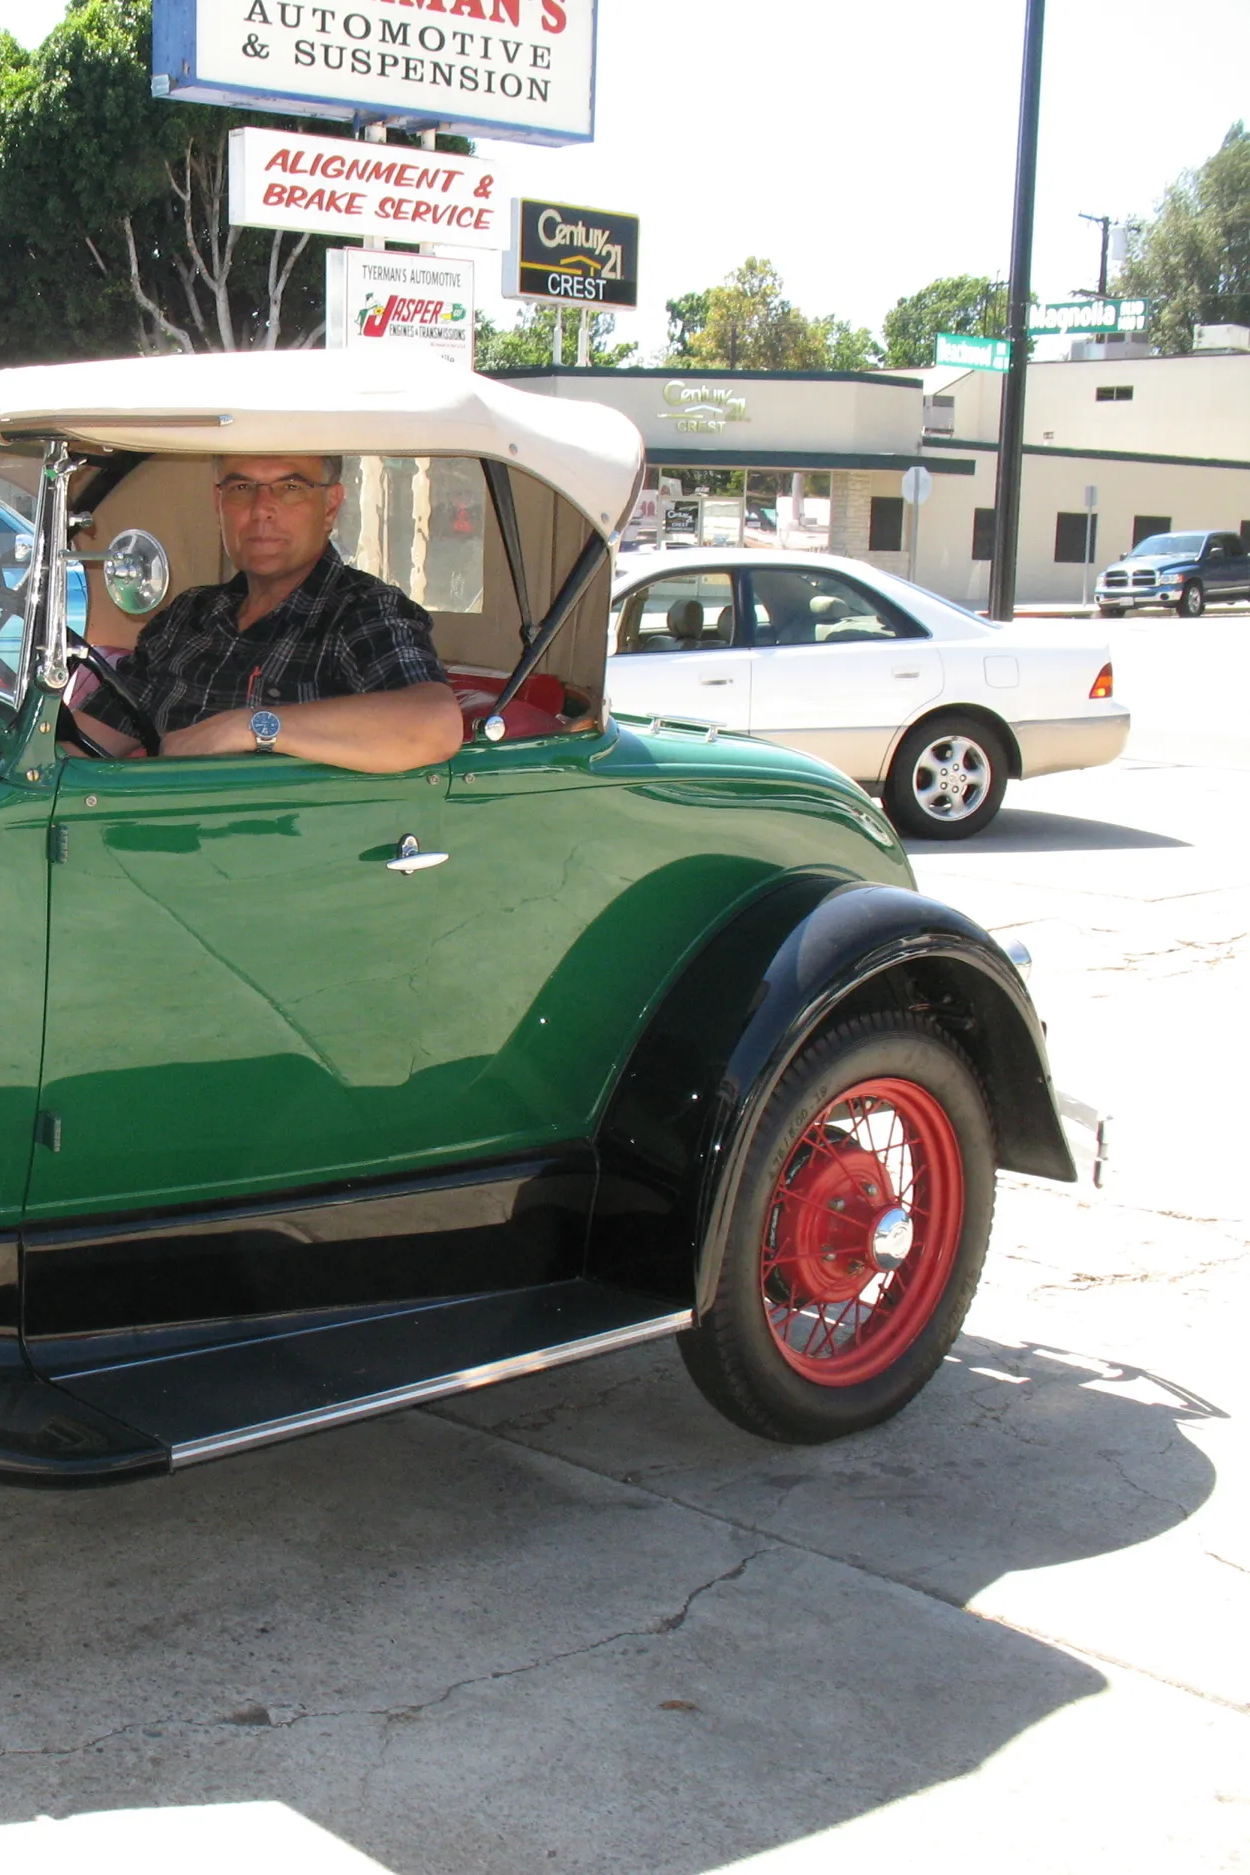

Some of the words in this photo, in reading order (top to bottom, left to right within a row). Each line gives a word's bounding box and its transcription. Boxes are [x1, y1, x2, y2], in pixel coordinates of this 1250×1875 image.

[244, 0, 552, 70] AUTOMOTIVE
[241, 33, 270, 59] &
[294, 40, 552, 102] SUSPENSION
[264, 149, 465, 193] ALIGNMENT
[473, 174, 495, 199] &
[262, 183, 368, 215] BRAKE
[374, 196, 495, 230] SERVICE
[537, 208, 610, 255] Century
[601, 243, 622, 280] 21
[362, 264, 407, 283] TYERMAN'S
[410, 269, 461, 288] AUTOMOTIVE
[548, 273, 607, 300] CREST
[363, 294, 444, 338] JASPER
[389, 323, 415, 338] ENGINES
[419, 326, 466, 341] TRANSMISSIONS
[1029, 301, 1116, 334] Magnolia
[676, 420, 727, 434] CREST
